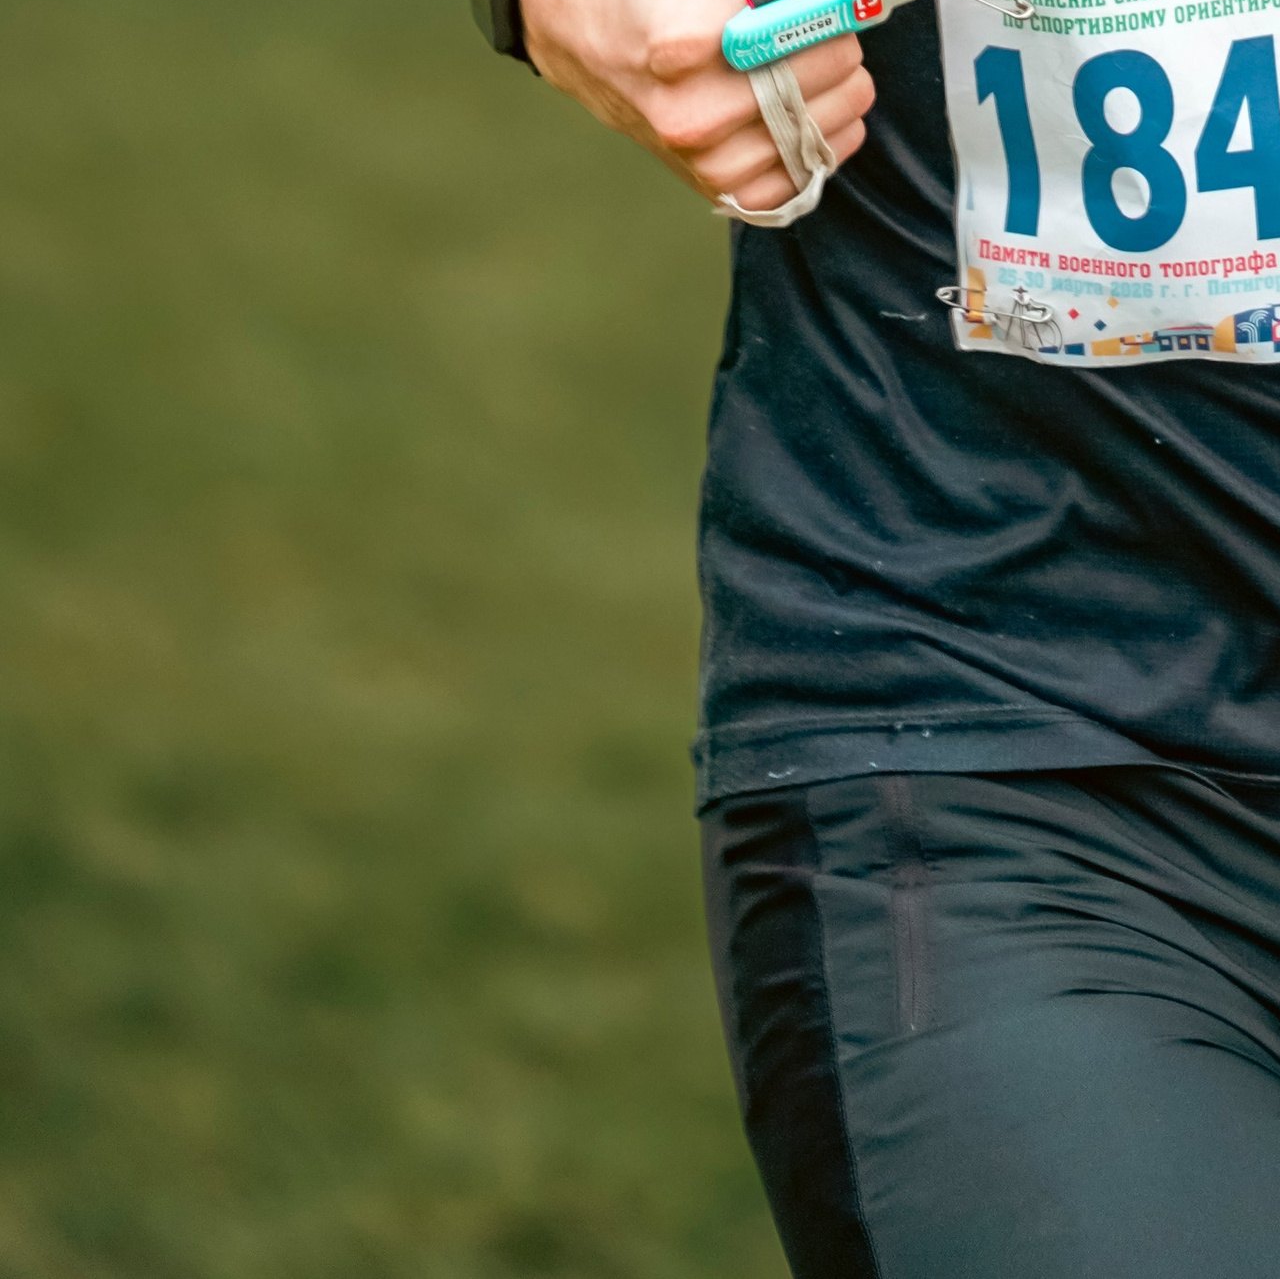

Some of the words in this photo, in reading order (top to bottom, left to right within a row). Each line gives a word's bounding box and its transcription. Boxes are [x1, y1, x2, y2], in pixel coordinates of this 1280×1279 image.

[777, 16, 833, 44] 8531143
[1030, 9, 1167, 36] СПОРТИВНОМУ
[978, 238, 1051, 269] Памяти
[1057, 254, 1151, 279] военного
[1159, 249, 1278, 279] топографа
[1050, 275, 1105, 298] марта
